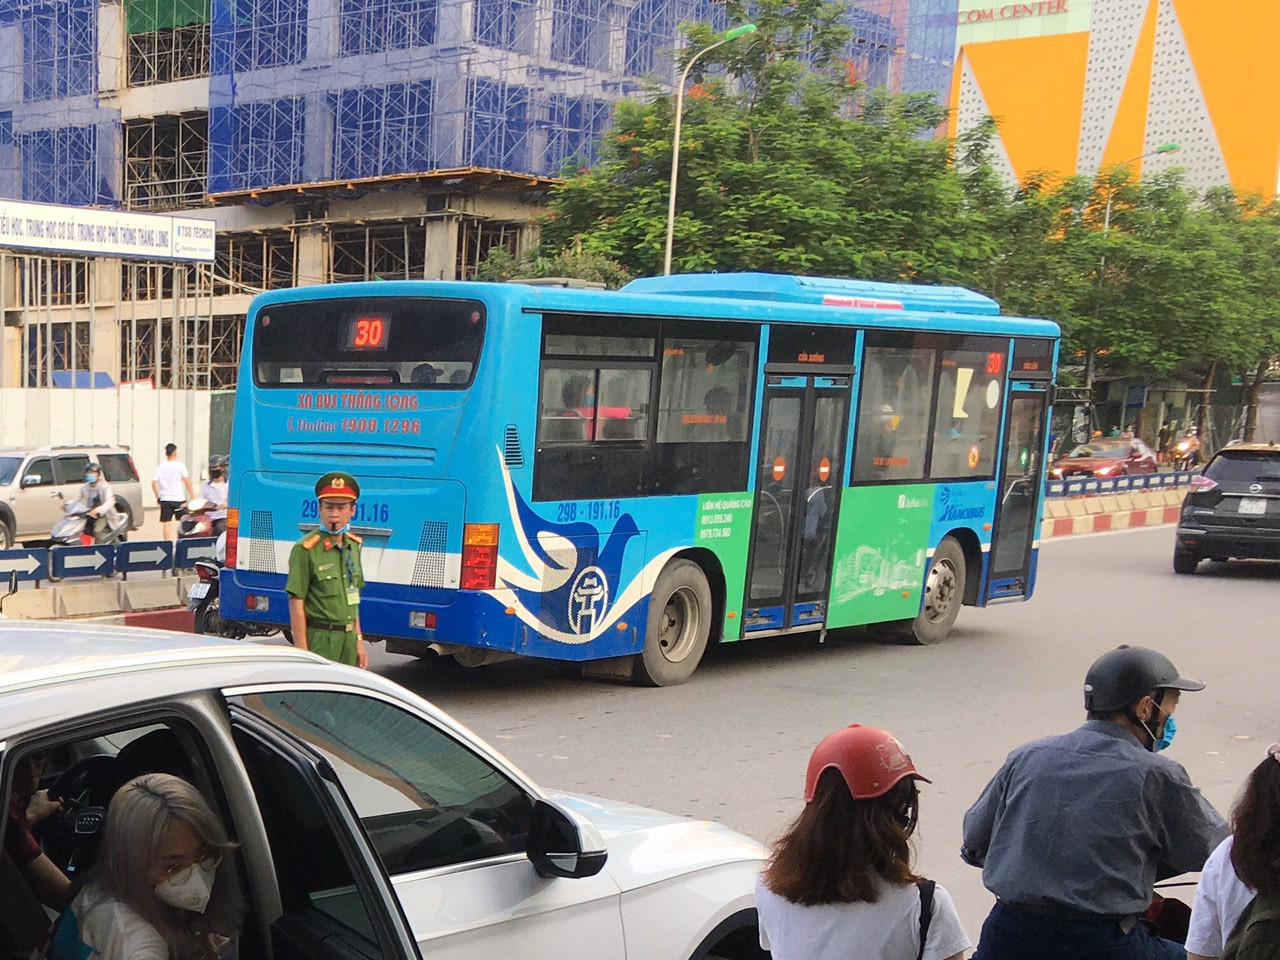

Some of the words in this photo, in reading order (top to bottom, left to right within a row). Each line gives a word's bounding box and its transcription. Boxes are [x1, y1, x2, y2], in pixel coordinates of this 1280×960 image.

[1000, 0, 1069, 20] CENTER
[354, 318, 383, 348] 30
[986, 352, 1003, 374] 30
[297, 393, 312, 409] XN
[315, 393, 338, 409] BUS
[340, 390, 382, 409] THĂNG
[384, 393, 419, 410] LONG
[297, 419, 338, 432] Hotline
[340, 418, 421, 434] 1900.1296
[557, 502, 577, 522] 29B
[587, 500, 621, 521] 191.16
